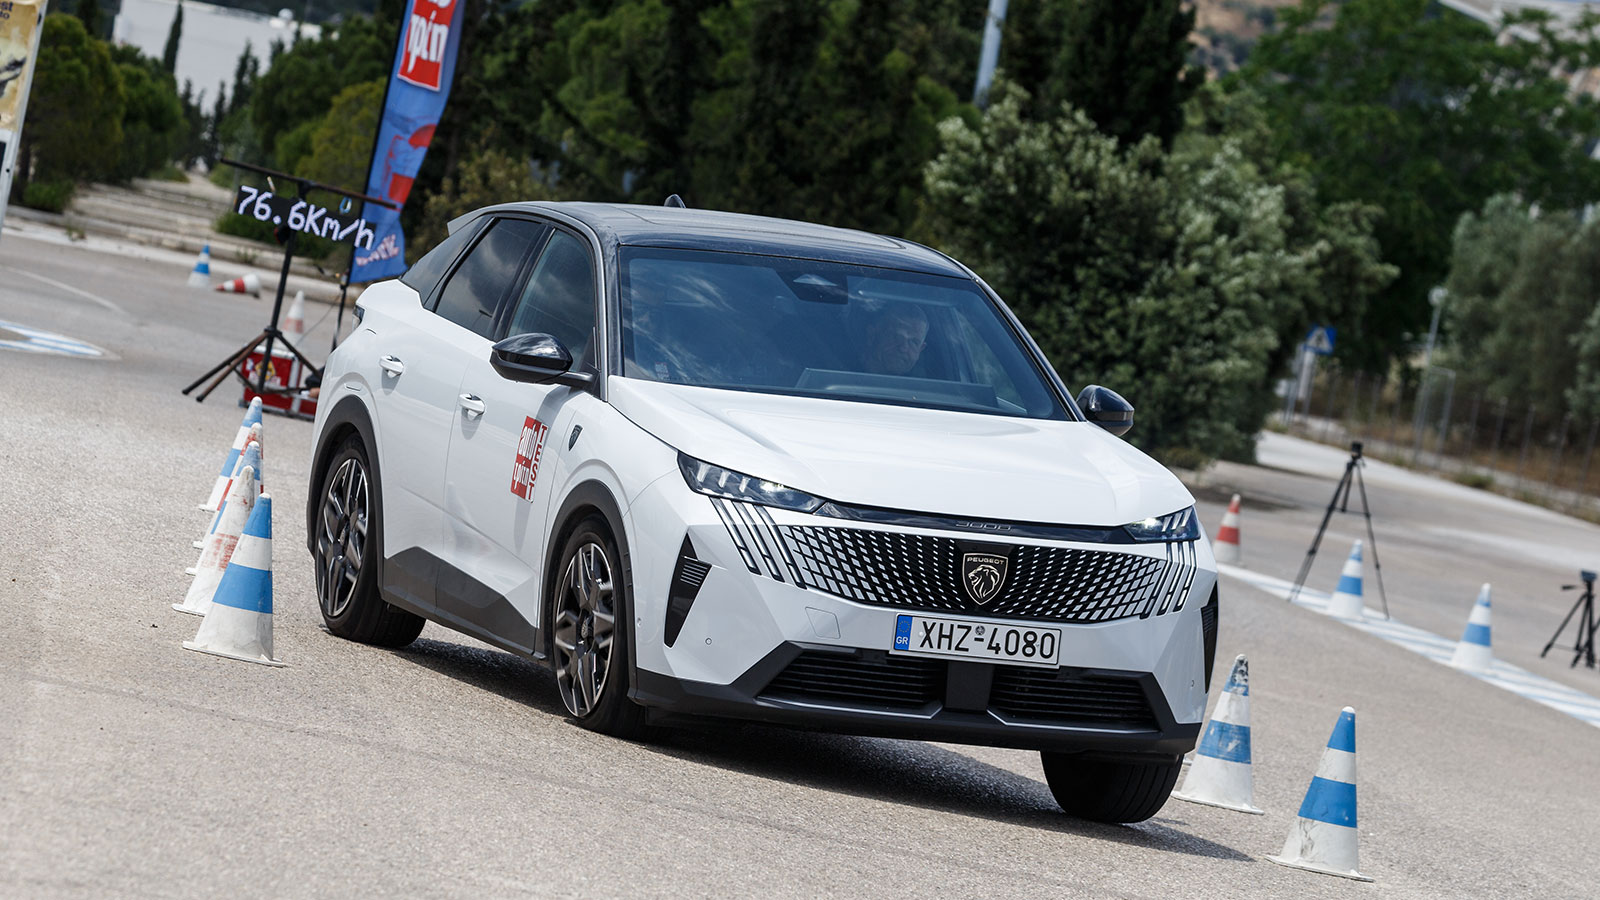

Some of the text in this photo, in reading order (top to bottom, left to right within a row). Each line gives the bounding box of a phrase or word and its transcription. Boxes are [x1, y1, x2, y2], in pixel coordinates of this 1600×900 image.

[237, 184, 375, 251] 76.6Km/h
[528, 424, 548, 501] TEST
[966, 556, 1005, 565] PEUGEOT
[895, 620, 1056, 659] GR XHZ-4080
